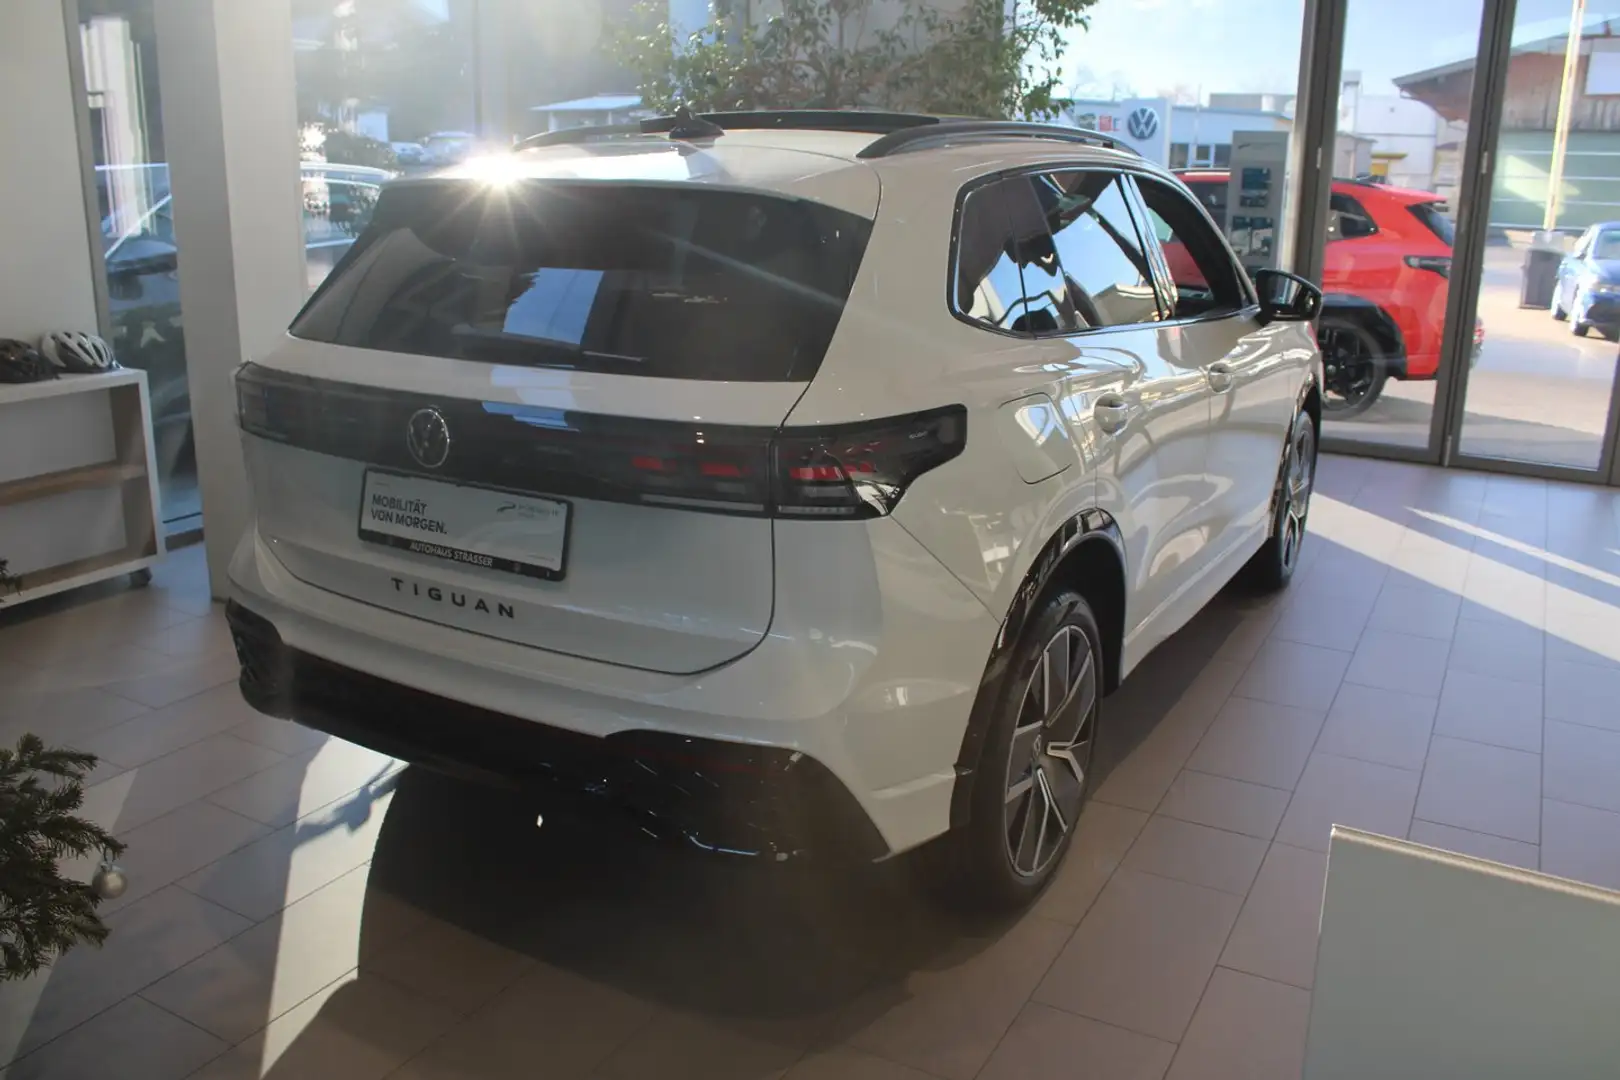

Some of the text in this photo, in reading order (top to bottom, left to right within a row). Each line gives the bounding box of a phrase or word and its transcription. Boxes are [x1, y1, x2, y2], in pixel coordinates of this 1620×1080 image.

[1127, 107, 1159, 140] VW
[372, 493, 428, 515] MOBILITÄT
[371, 508, 448, 534] VON MORGEN.
[409, 542, 493, 567] AUTOHAUS STRASSER
[391, 577, 515, 619] TIGUAN
